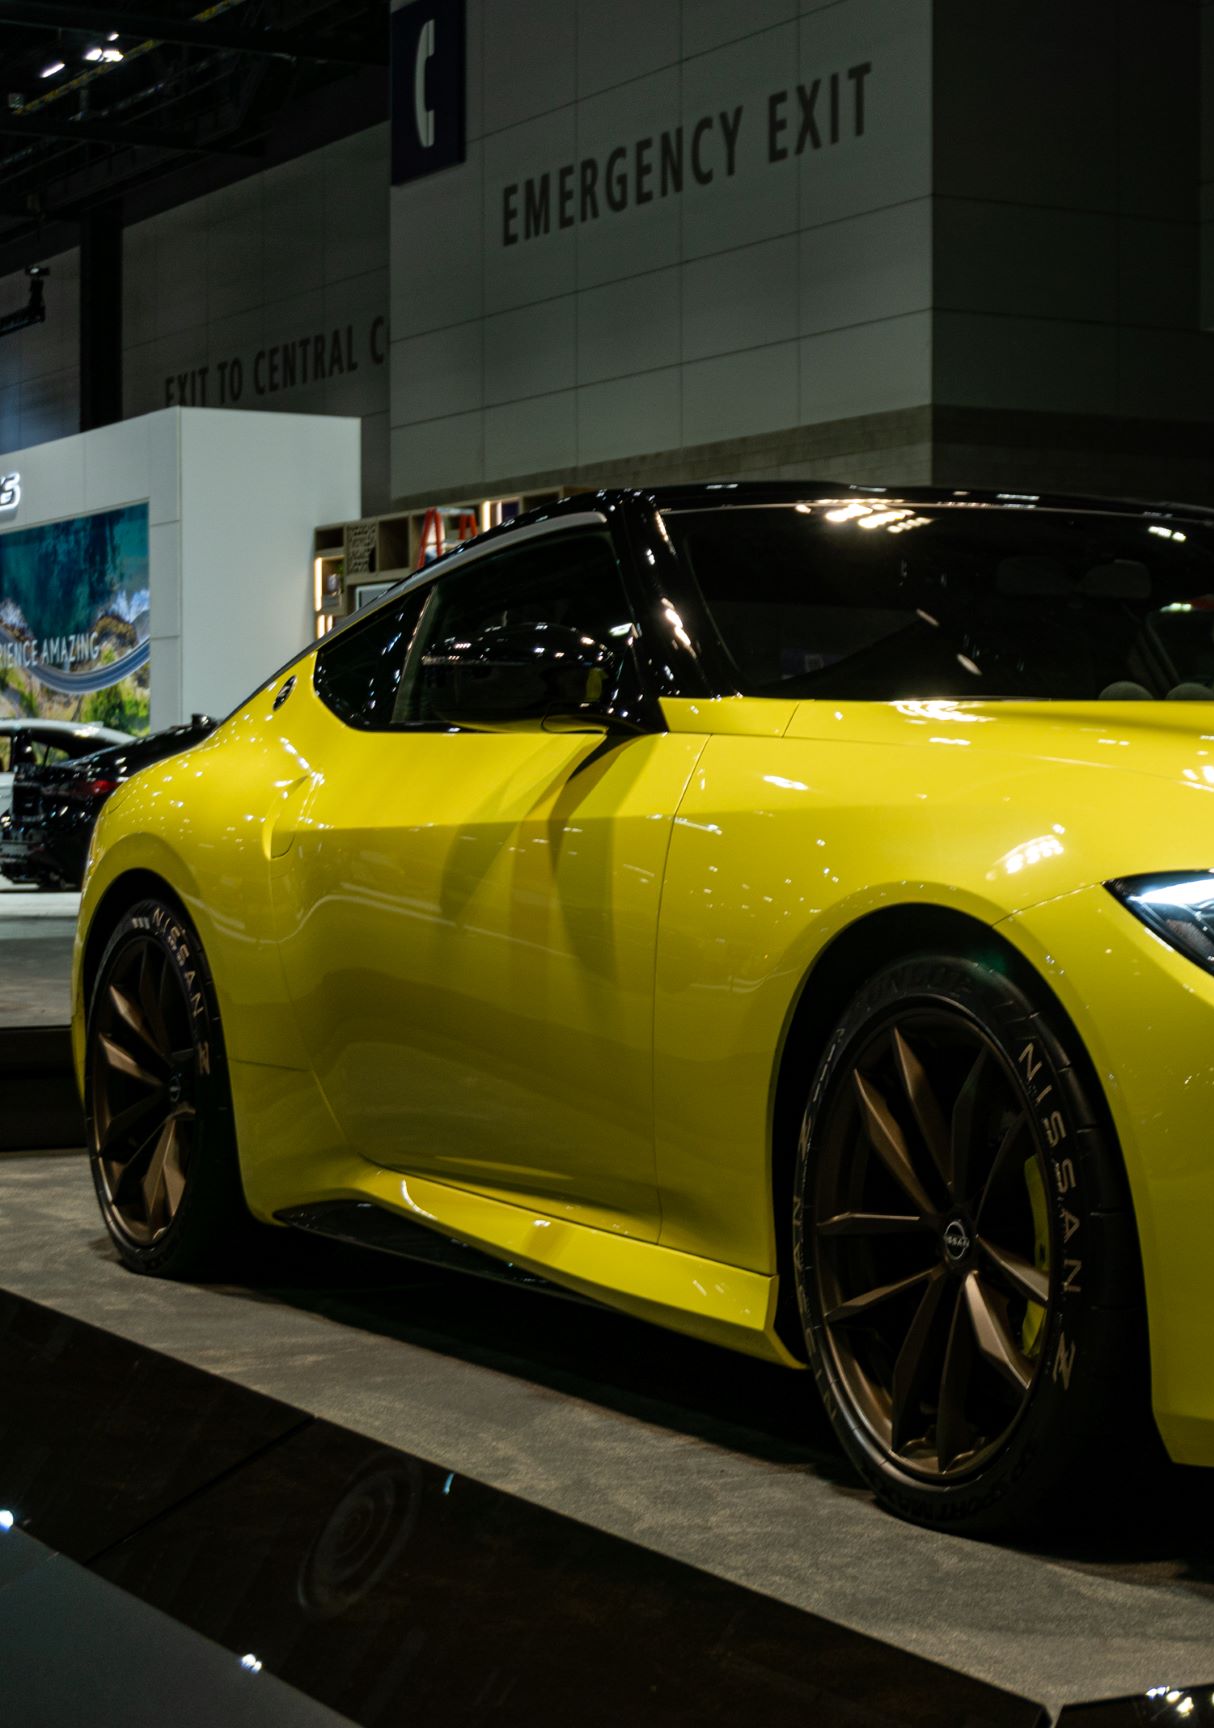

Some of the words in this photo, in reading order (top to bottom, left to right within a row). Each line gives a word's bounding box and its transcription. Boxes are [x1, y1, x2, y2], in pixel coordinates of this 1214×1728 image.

[502, 105, 743, 247] EMERGENCY
[769, 62, 872, 163] EXIT
[165, 367, 209, 406] EXIT
[218, 358, 243, 404] TO
[255, 325, 358, 395] CENTRAL
[370, 316, 391, 364] C
[42, 631, 101, 664] AMAZING
[152, 905, 206, 1018] NISSAN
[1018, 1040, 1082, 1294] NISSAN
